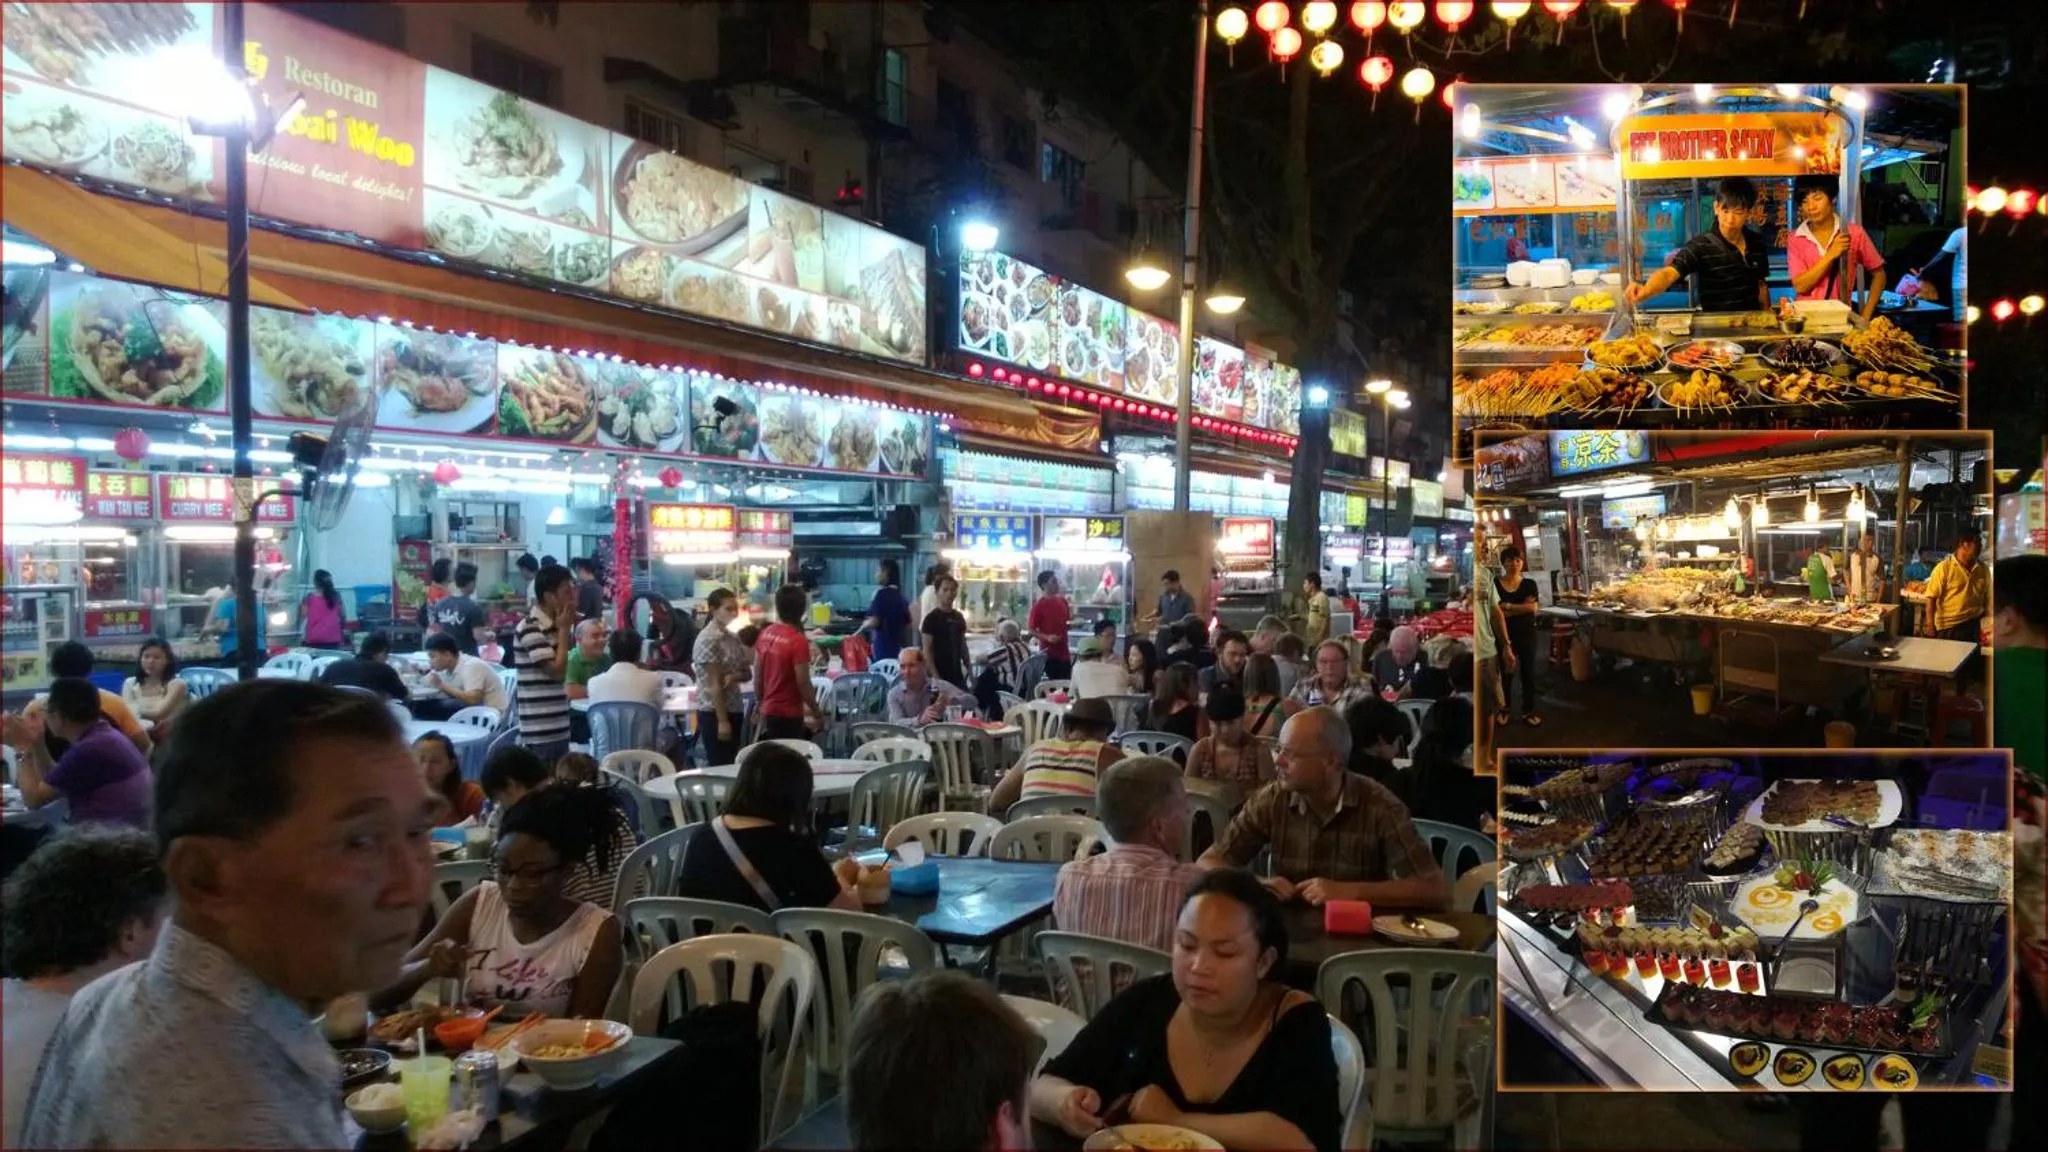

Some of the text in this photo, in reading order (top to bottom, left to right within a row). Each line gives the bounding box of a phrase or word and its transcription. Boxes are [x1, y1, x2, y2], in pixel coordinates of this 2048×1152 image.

[284, 55, 379, 109] Restoran
[344, 115, 416, 168] Woo
[1658, 129, 1729, 161] BROTHER
[1729, 127, 1776, 159] SATAY
[311, 163, 349, 187] local
[351, 175, 414, 203] delights!
[133, 500, 150, 517] MEE
[171, 502, 224, 517] CURRY MEE
